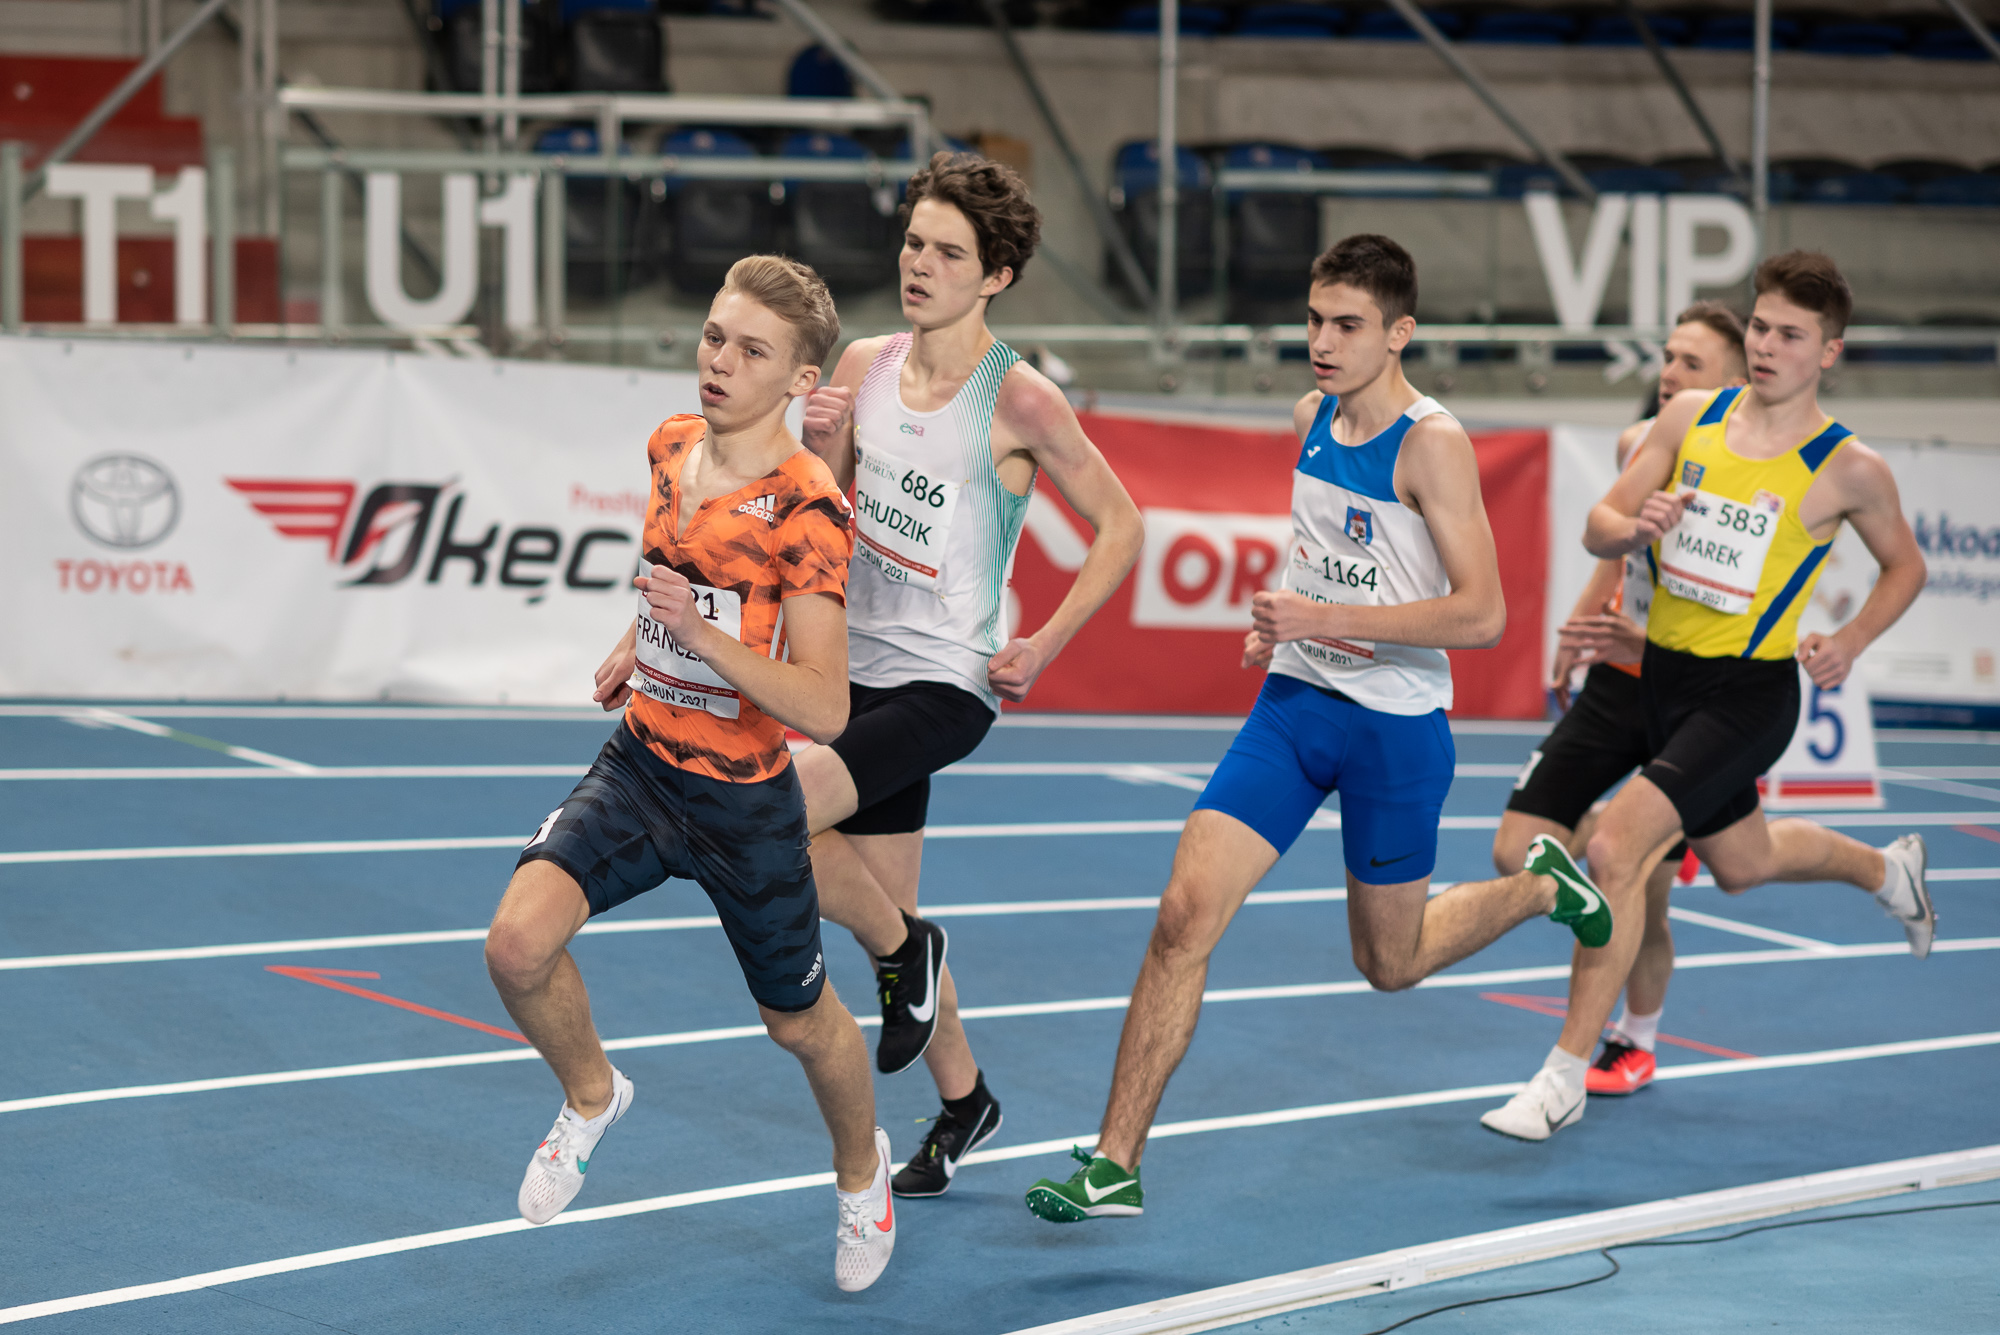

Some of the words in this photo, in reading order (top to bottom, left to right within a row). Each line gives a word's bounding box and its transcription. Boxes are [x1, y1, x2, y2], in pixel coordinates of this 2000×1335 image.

[47, 163, 207, 328] T1
[364, 171, 540, 332] U1
[1522, 193, 1758, 332] VIP
[900, 422, 925, 437] esa
[864, 459, 897, 482] TORUŃ
[901, 469, 946, 508] 686
[738, 503, 775, 523] adidas
[856, 490, 933, 546] CHUDZIK
[1717, 503, 1768, 537] 583
[336, 478, 640, 606] Okęc
[857, 541, 883, 569] TORUŃ
[884, 563, 908, 582] 2021
[1676, 531, 1743, 569] MAREK
[54, 561, 193, 594] TOYOTA
[1163, 533, 1293, 608] OR
[1322, 555, 1378, 592] 1164
[636, 613, 702, 662] FRANCZ
[1329, 650, 1353, 666] 2021
[641, 678, 676, 702] TORUŃ
[679, 692, 708, 711] 2021
[1808, 682, 1846, 762] 5
